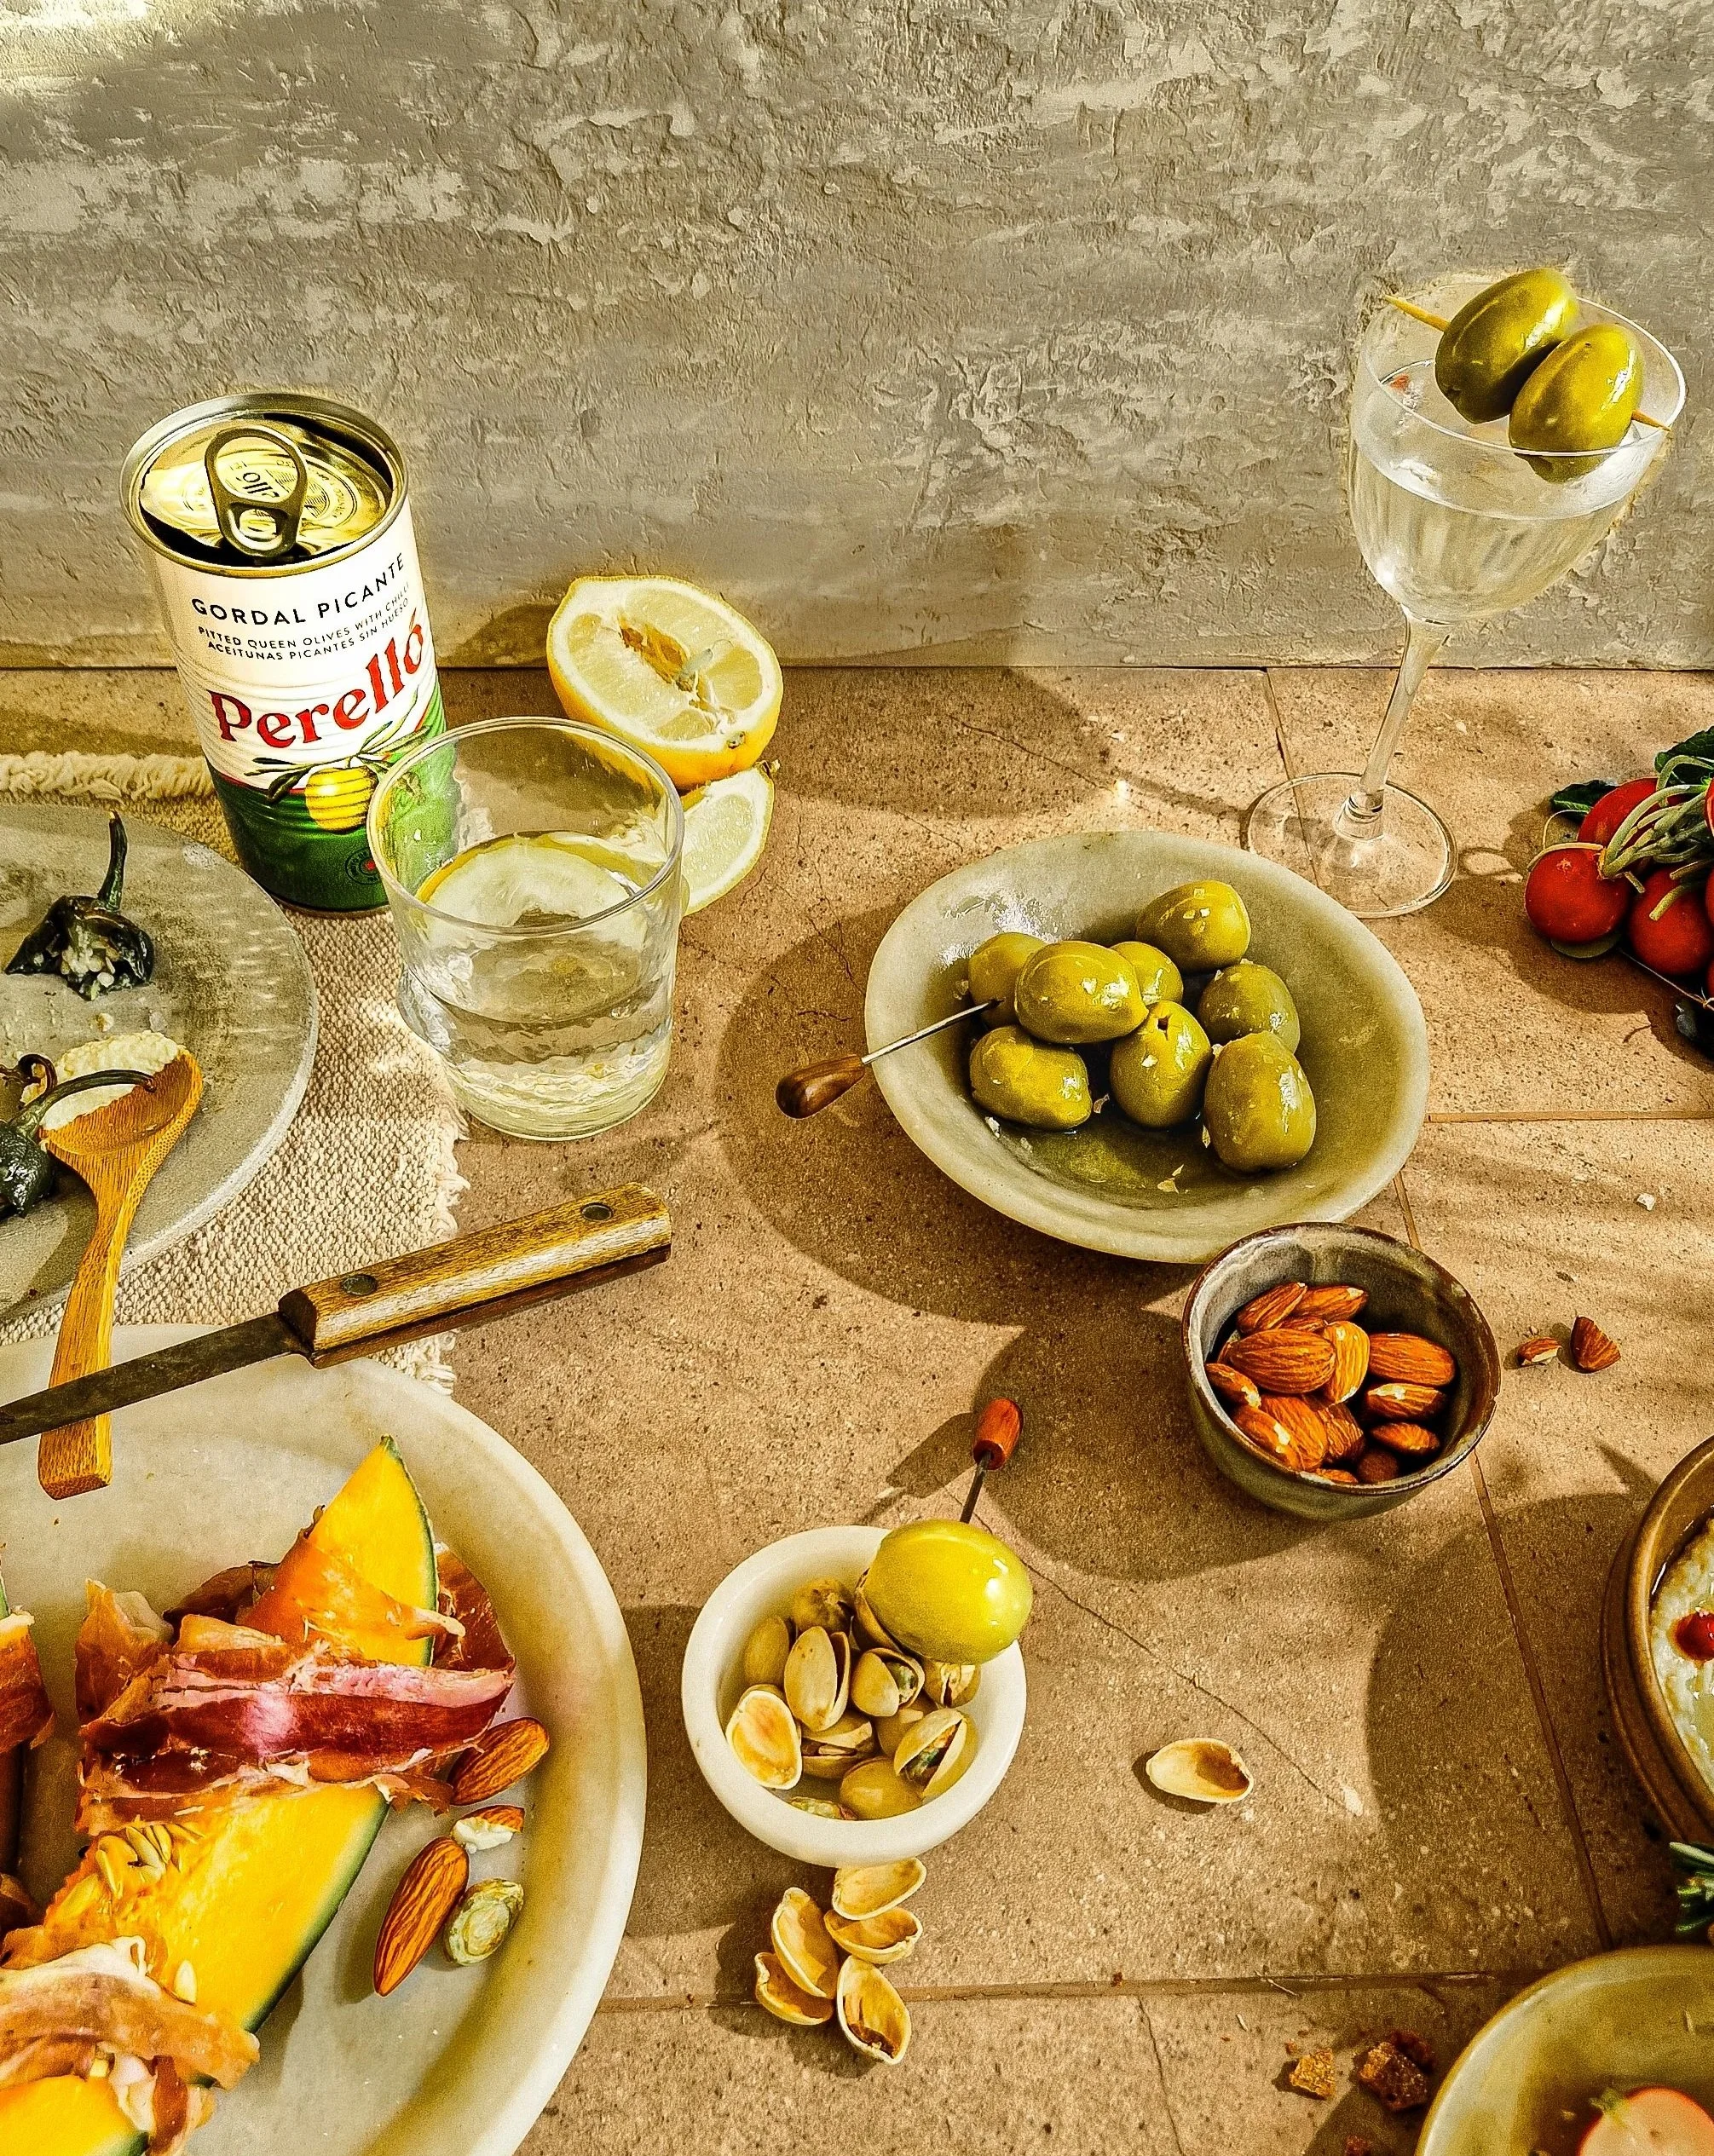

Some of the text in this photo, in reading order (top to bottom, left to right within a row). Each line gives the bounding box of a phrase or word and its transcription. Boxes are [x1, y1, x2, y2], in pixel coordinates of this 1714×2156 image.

[191, 552, 405, 625] GORDAL PICANTE
[198, 625, 242, 646] PITTED
[247, 639, 297, 650] QUEEN
[303, 626, 350, 646] OLIVES
[355, 609, 382, 630] WITH
[207, 597, 408, 660] ACEITUNAS PICANTES SIN HUESO
[206, 607, 424, 748] Perelló
